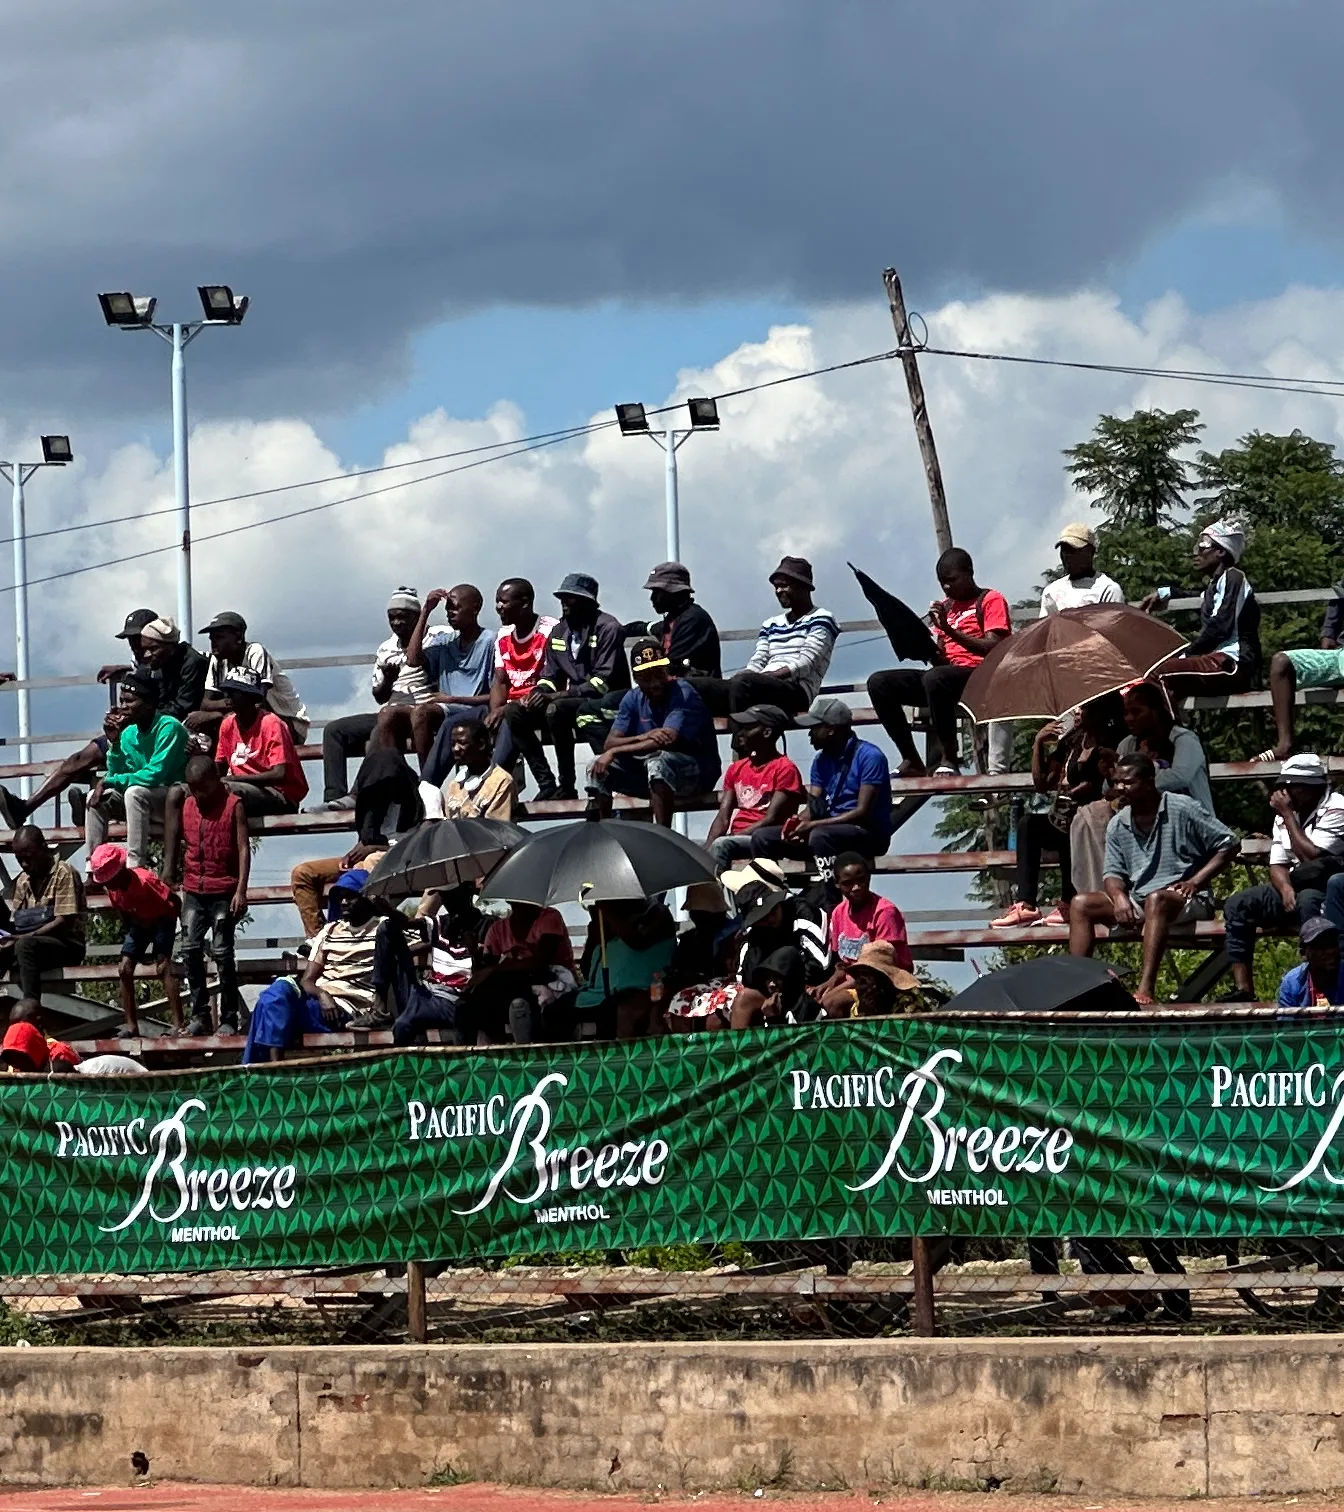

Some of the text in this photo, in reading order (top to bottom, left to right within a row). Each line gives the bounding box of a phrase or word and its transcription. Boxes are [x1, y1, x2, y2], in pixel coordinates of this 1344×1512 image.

[790, 1065, 896, 1111] PACIFIC
[1211, 1063, 1326, 1108] PACIFIC
[55, 1117, 148, 1158] PACIFIC
[408, 1094, 506, 1140] PACIFIC
[845, 1048, 1074, 1192] Breeze
[98, 1097, 296, 1233] Breeze
[451, 1071, 669, 1216] Breeze
[534, 1204, 611, 1225] MENTHOL
[926, 1188, 1009, 1206] MENTHOL
[171, 1224, 241, 1243] MENTHOL
